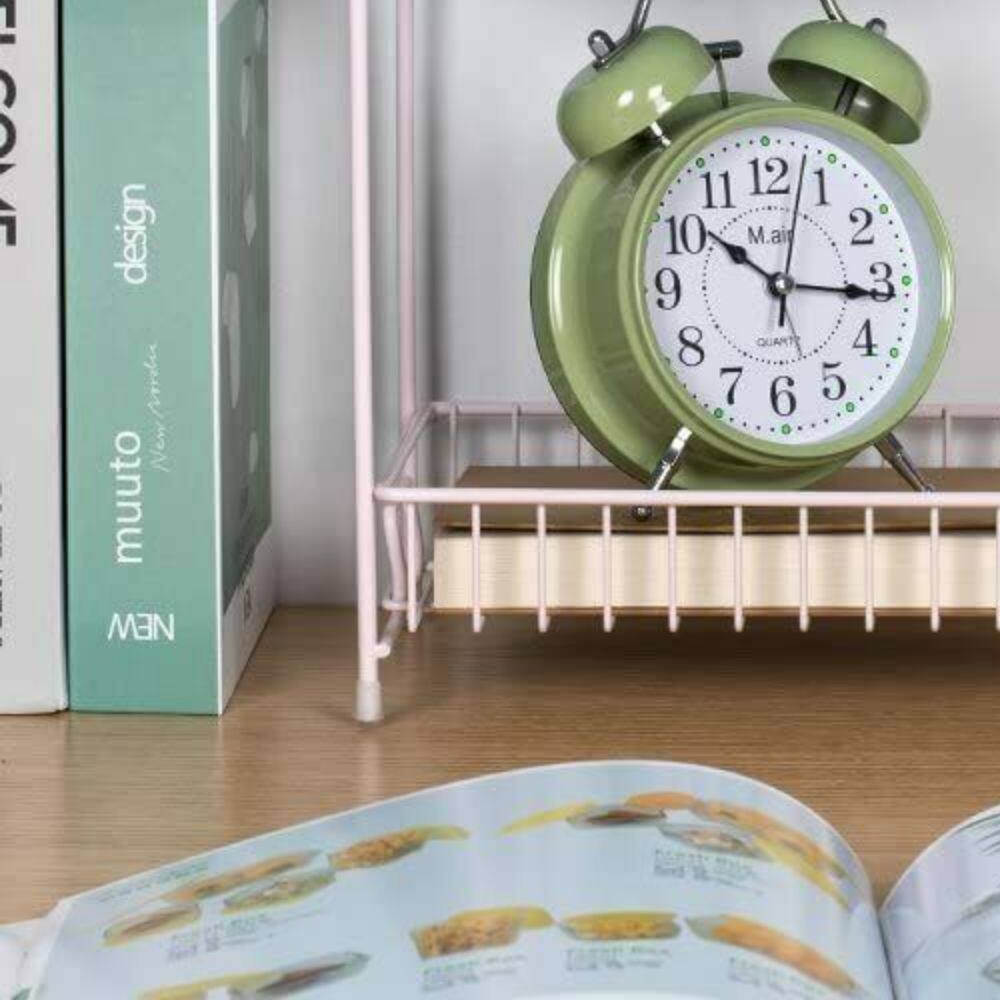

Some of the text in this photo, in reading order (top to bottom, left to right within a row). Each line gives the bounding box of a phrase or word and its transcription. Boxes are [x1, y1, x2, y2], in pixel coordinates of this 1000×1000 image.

[700, 171, 736, 209] 11
[749, 157, 791, 195] 12
[814, 168, 831, 206] 1
[113, 184, 156, 285] design
[665, 213, 707, 255] 10
[849, 207, 875, 246] 2
[654, 267, 681, 311] 9
[869, 262, 895, 303] 3
[678, 326, 705, 366] 8
[852, 319, 878, 357] 4
[720, 366, 743, 405] 7
[770, 375, 797, 416] 6
[821, 361, 847, 400] 5
[109, 431, 143, 564] muuto
[107, 613, 175, 641] NEW
